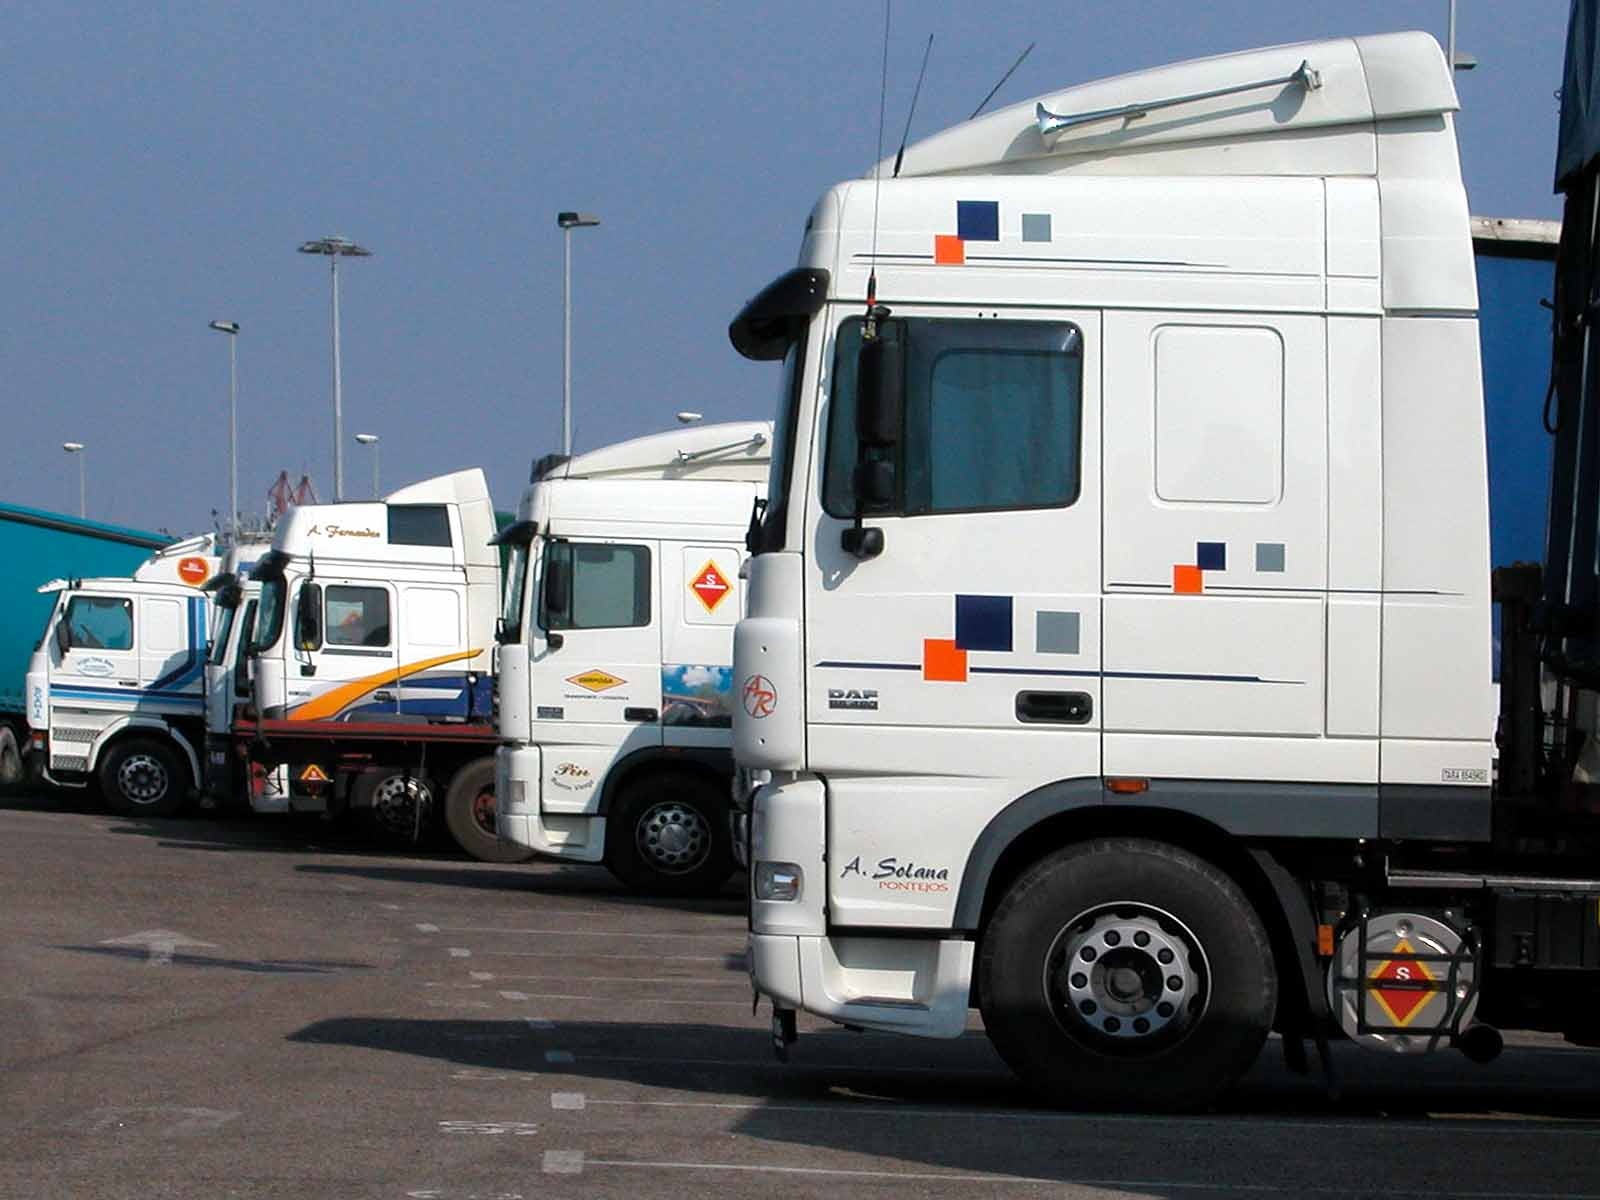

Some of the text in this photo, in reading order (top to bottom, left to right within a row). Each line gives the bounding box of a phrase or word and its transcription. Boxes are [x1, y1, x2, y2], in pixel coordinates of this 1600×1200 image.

[705, 574, 716, 586] S
[828, 689, 878, 699] DAF
[840, 855, 949, 880] A. Solana
[879, 881, 949, 892] PONTEJOS
[1395, 966, 1410, 980] S
